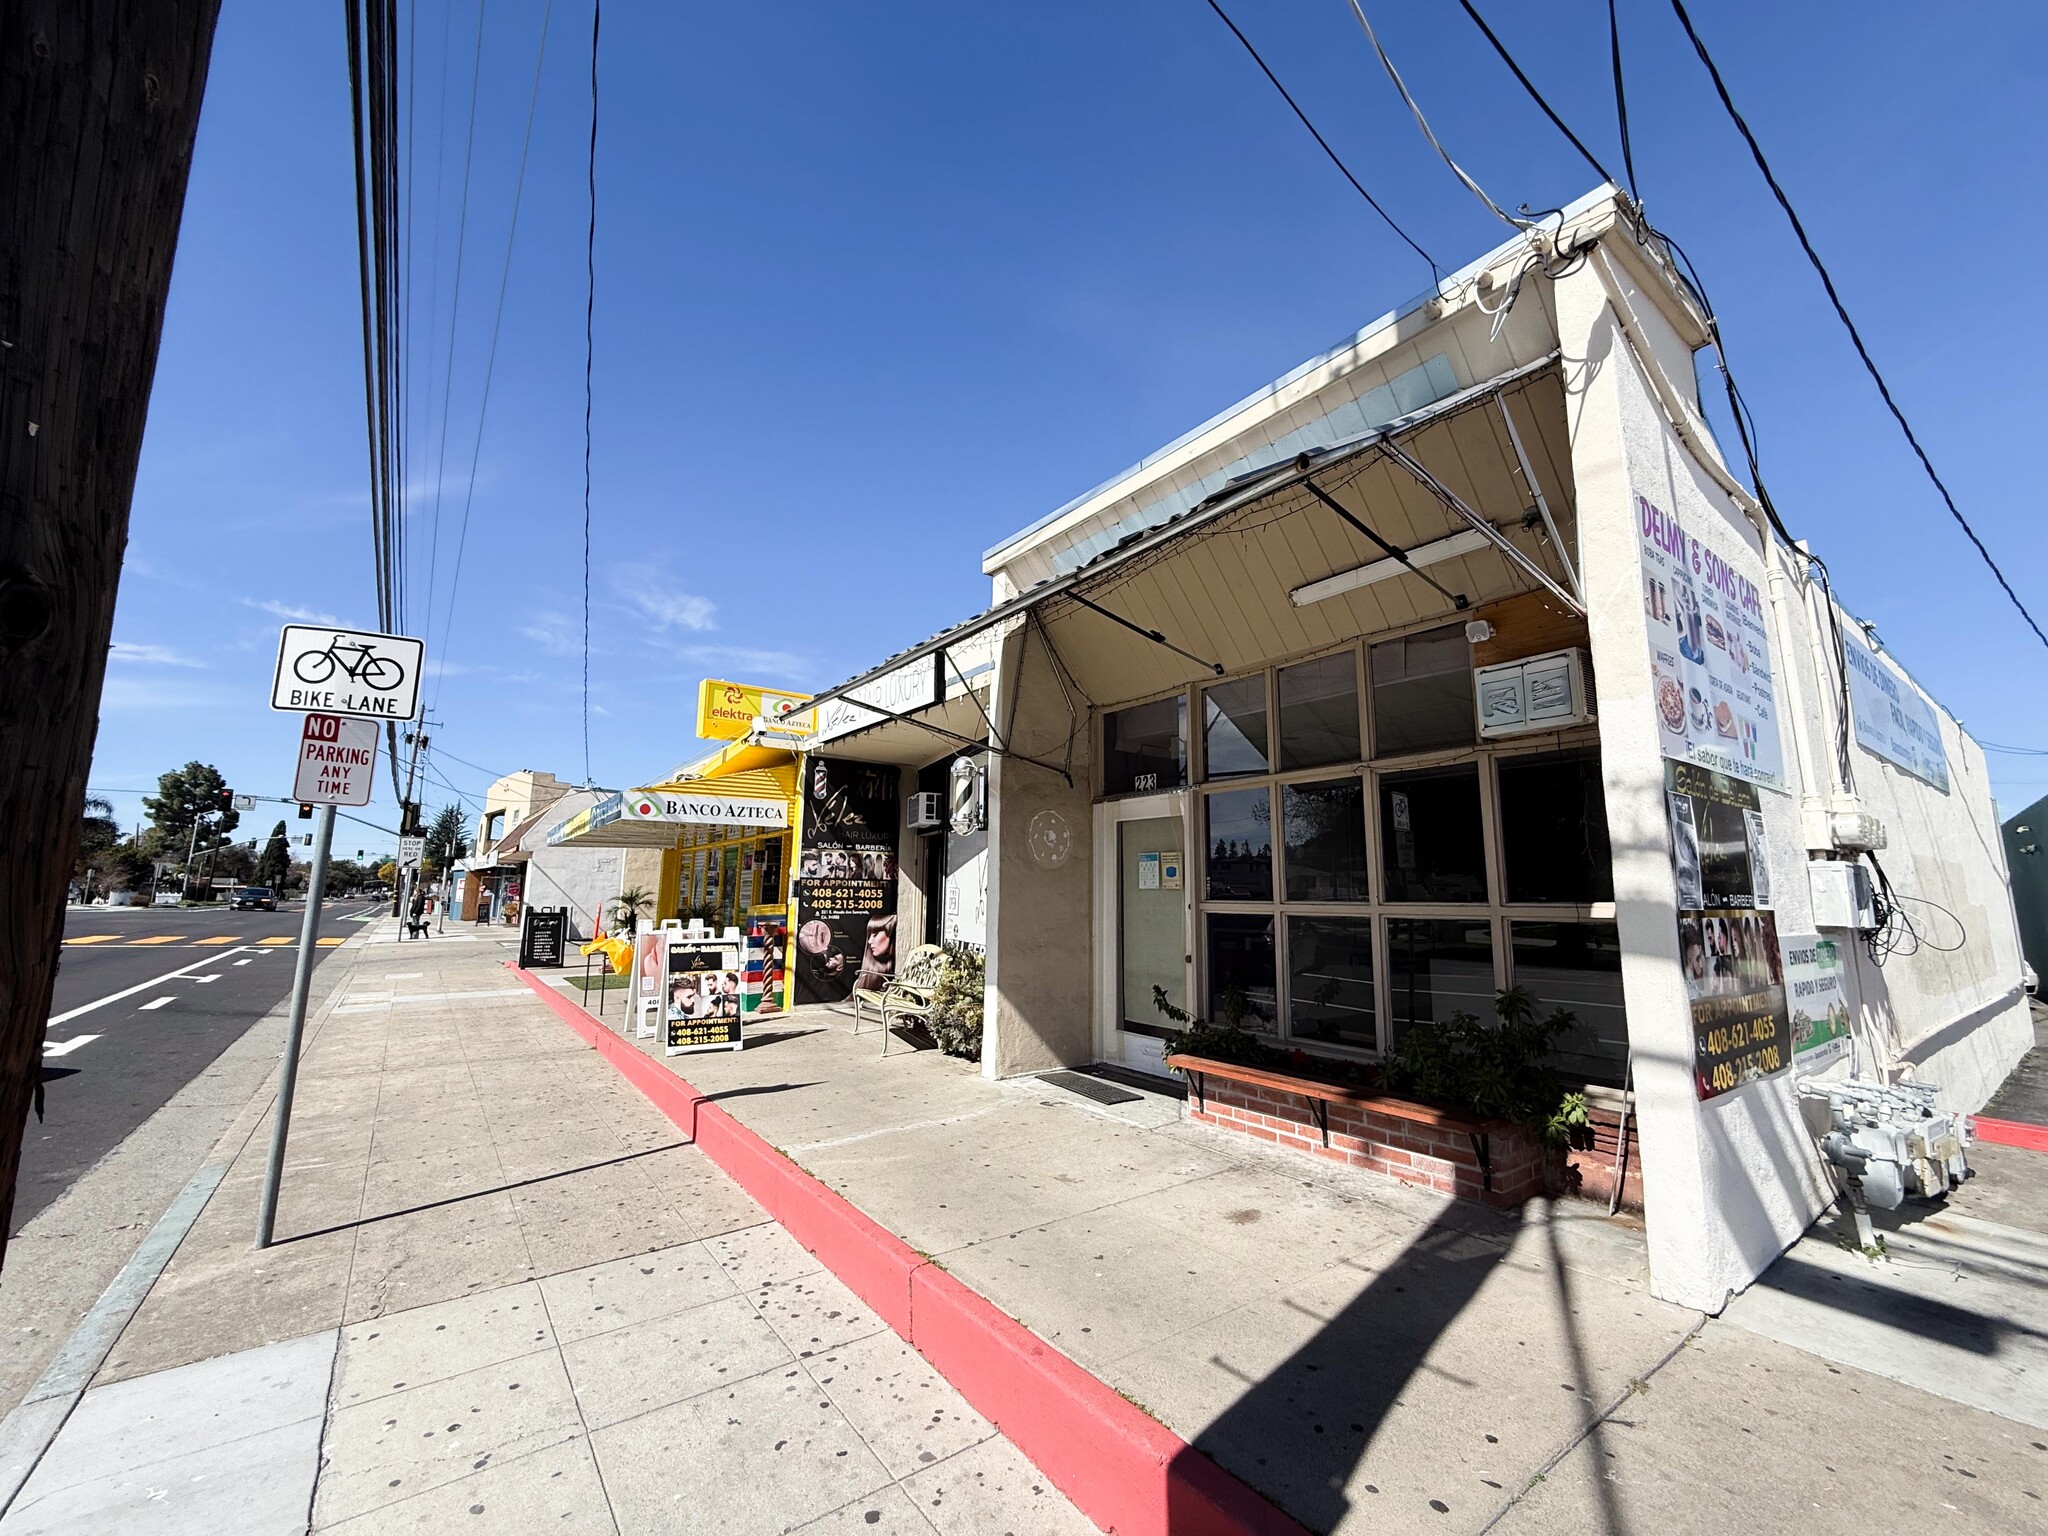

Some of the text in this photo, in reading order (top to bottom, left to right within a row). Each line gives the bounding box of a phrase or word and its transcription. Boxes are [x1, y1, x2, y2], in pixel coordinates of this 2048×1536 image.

[1639, 495, 1686, 565] DELMY
[1691, 538, 1701, 575] &
[1704, 548, 1736, 601] SONS
[290, 689, 398, 714] BIKE LANE
[712, 707, 753, 721] elektra
[307, 717, 336, 738] NO
[787, 720, 812, 729] AZTECA
[306, 744, 370, 765] PARKING
[1697, 748, 1718, 767] sabor
[1720, 756, 1732, 773] que
[1733, 758, 1740, 774] te
[320, 765, 351, 779] ANY
[317, 780, 351, 795] TIME
[1136, 774, 1156, 792] 223
[666, 800, 783, 819] BANCO AZTECA
[817, 841, 844, 849] SALÓN
[855, 843, 892, 852] BARBERÍA
[811, 888, 884, 898] 408-621-4055
[1703, 888, 1721, 906] ALÓN
[1729, 894, 1755, 907] BARBER
[811, 899, 884, 909] 408-215-2008
[1692, 1003, 1713, 1025] FOR
[676, 1026, 729, 1036] 408-621-4055
[676, 1035, 729, 1045] 408-215-2008
[1707, 1015, 1776, 1055] 408-621-4055
